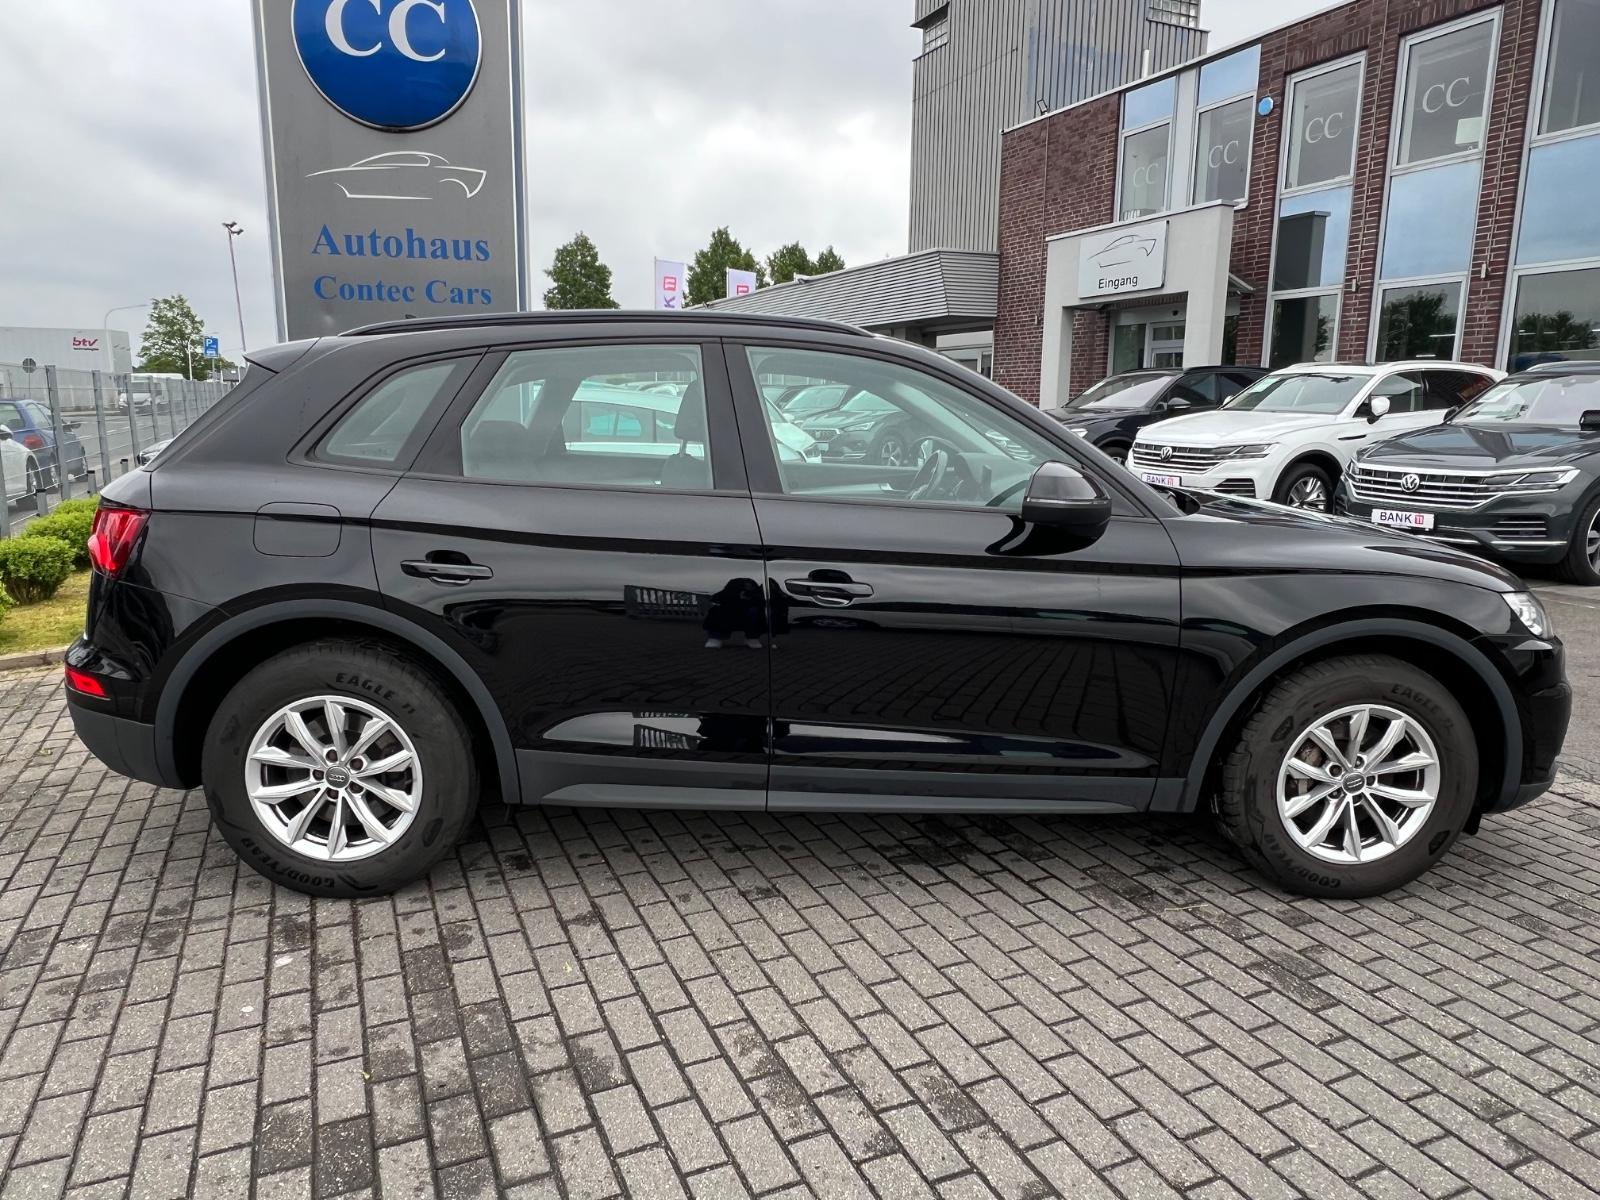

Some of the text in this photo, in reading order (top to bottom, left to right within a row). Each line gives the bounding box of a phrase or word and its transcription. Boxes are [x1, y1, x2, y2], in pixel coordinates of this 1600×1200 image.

[325, 0, 446, 62] CC
[1422, 77, 1470, 113] CC
[1305, 112, 1343, 144] CC
[1208, 140, 1239, 168] CC
[312, 223, 491, 262] Autohaus
[313, 275, 492, 306] Contec Cars
[1098, 276, 1138, 290] Eingang
[72, 336, 98, 347] btv
[206, 338, 213, 348] P
[1380, 511, 1412, 524] BANK
[335, 672, 396, 701] EAGLE
[1391, 684, 1442, 714] EAGLE
[241, 838, 335, 888] GOODYEAR
